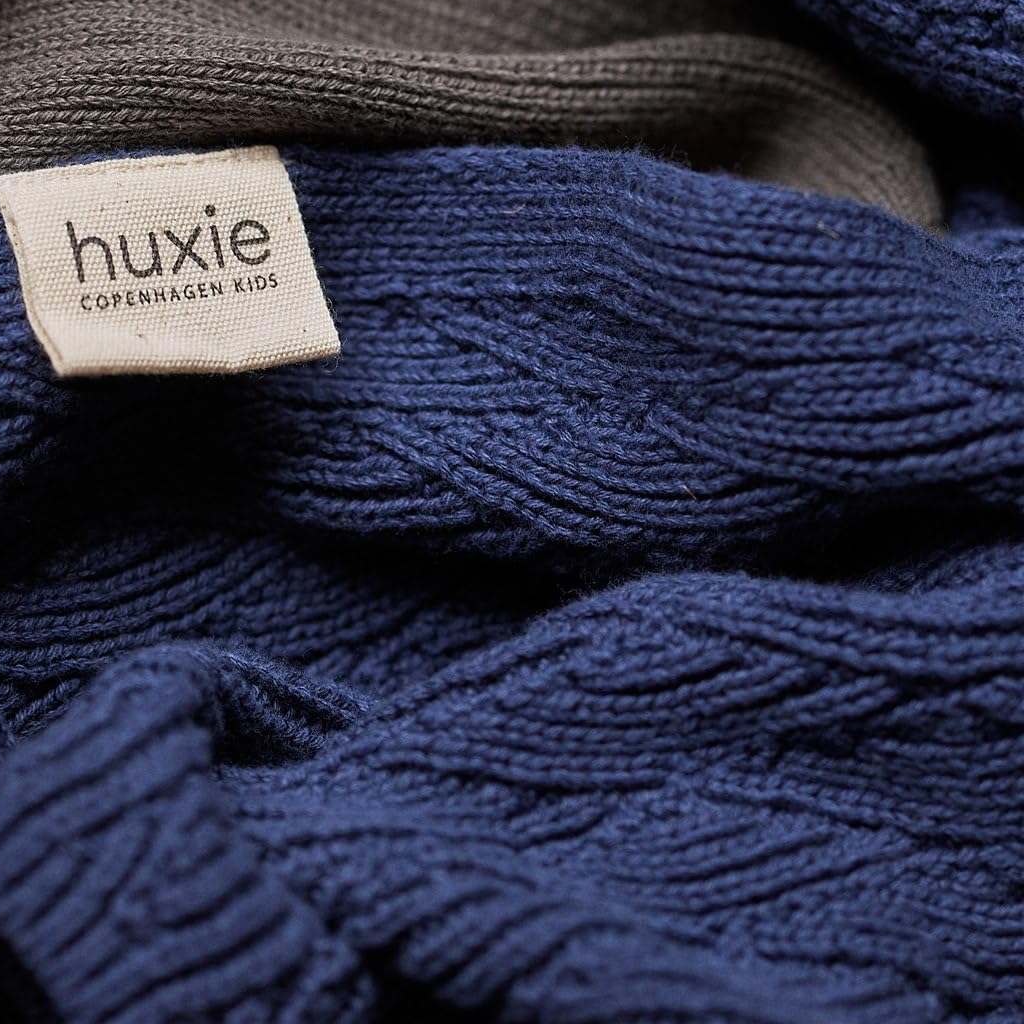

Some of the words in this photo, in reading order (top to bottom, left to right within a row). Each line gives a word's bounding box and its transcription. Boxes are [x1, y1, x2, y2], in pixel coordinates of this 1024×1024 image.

[65, 204, 272, 284] huxie
[80, 282, 224, 311] COPENHAGEN
[233, 272, 279, 294] KIDS
